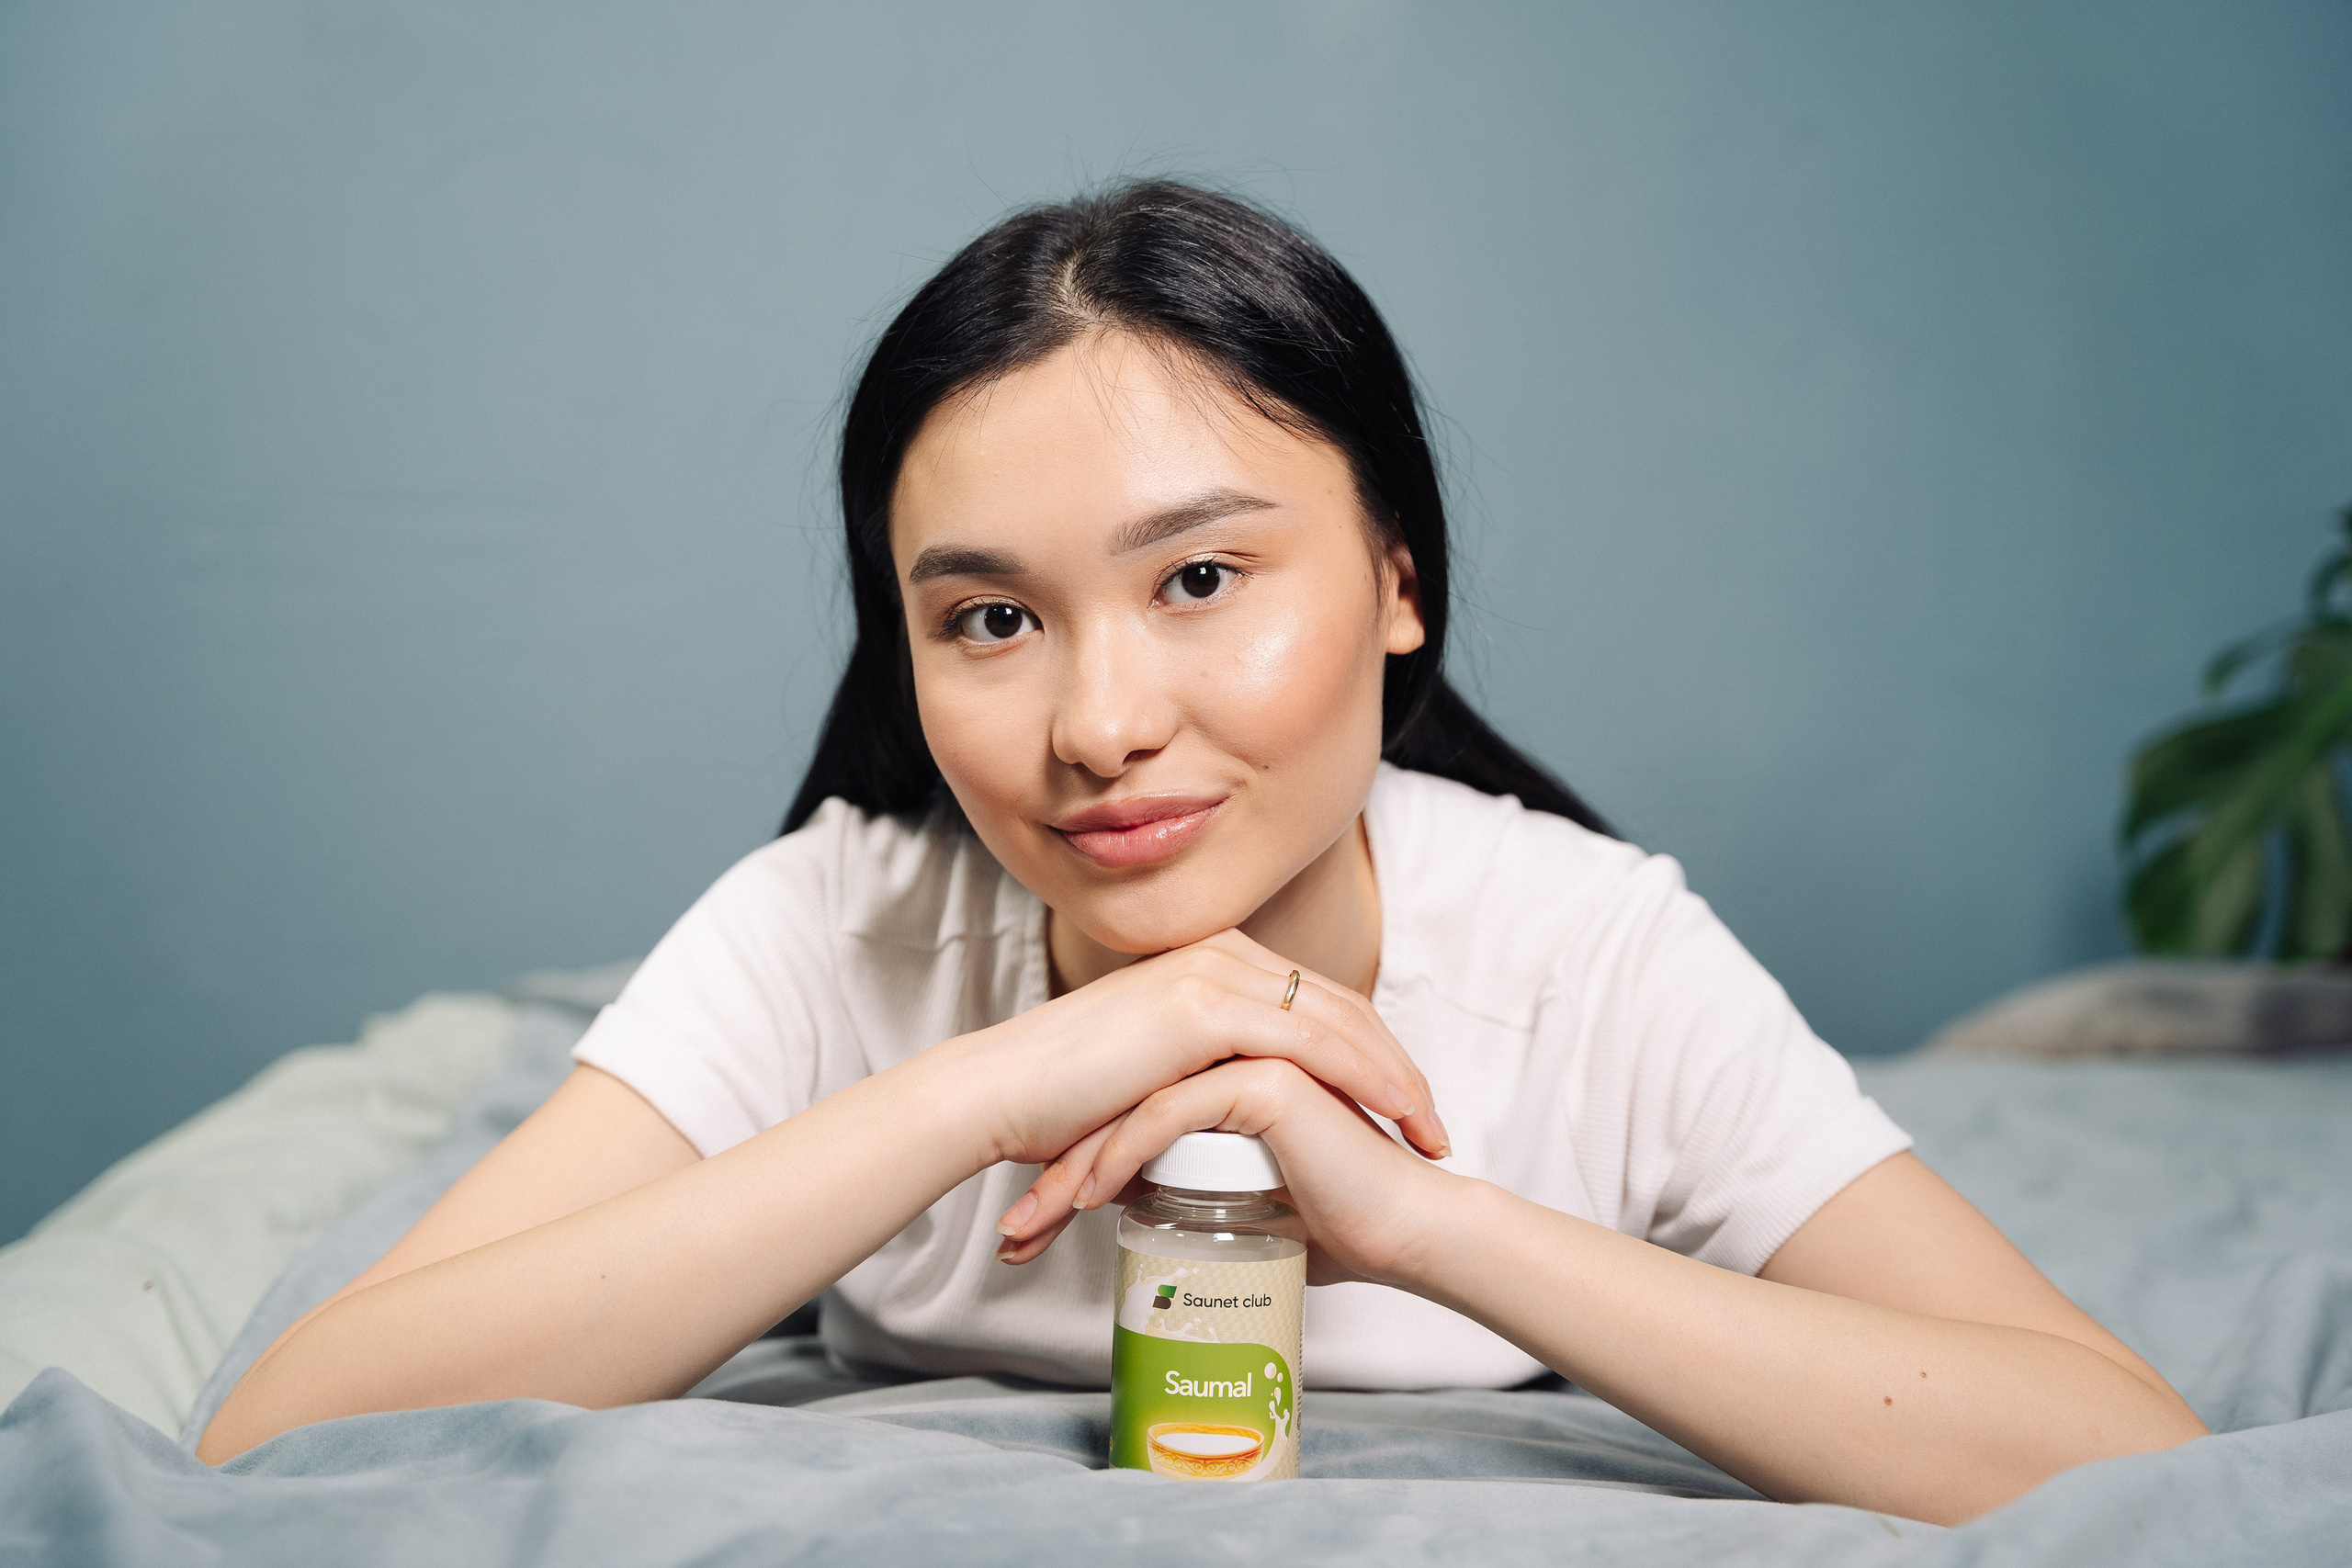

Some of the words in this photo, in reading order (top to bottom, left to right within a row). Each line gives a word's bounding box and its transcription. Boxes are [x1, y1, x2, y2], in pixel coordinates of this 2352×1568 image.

[1182, 1292, 1238, 1308] Saunet
[1242, 1293, 1272, 1308] club
[1164, 1370, 1252, 1398] Saumal
